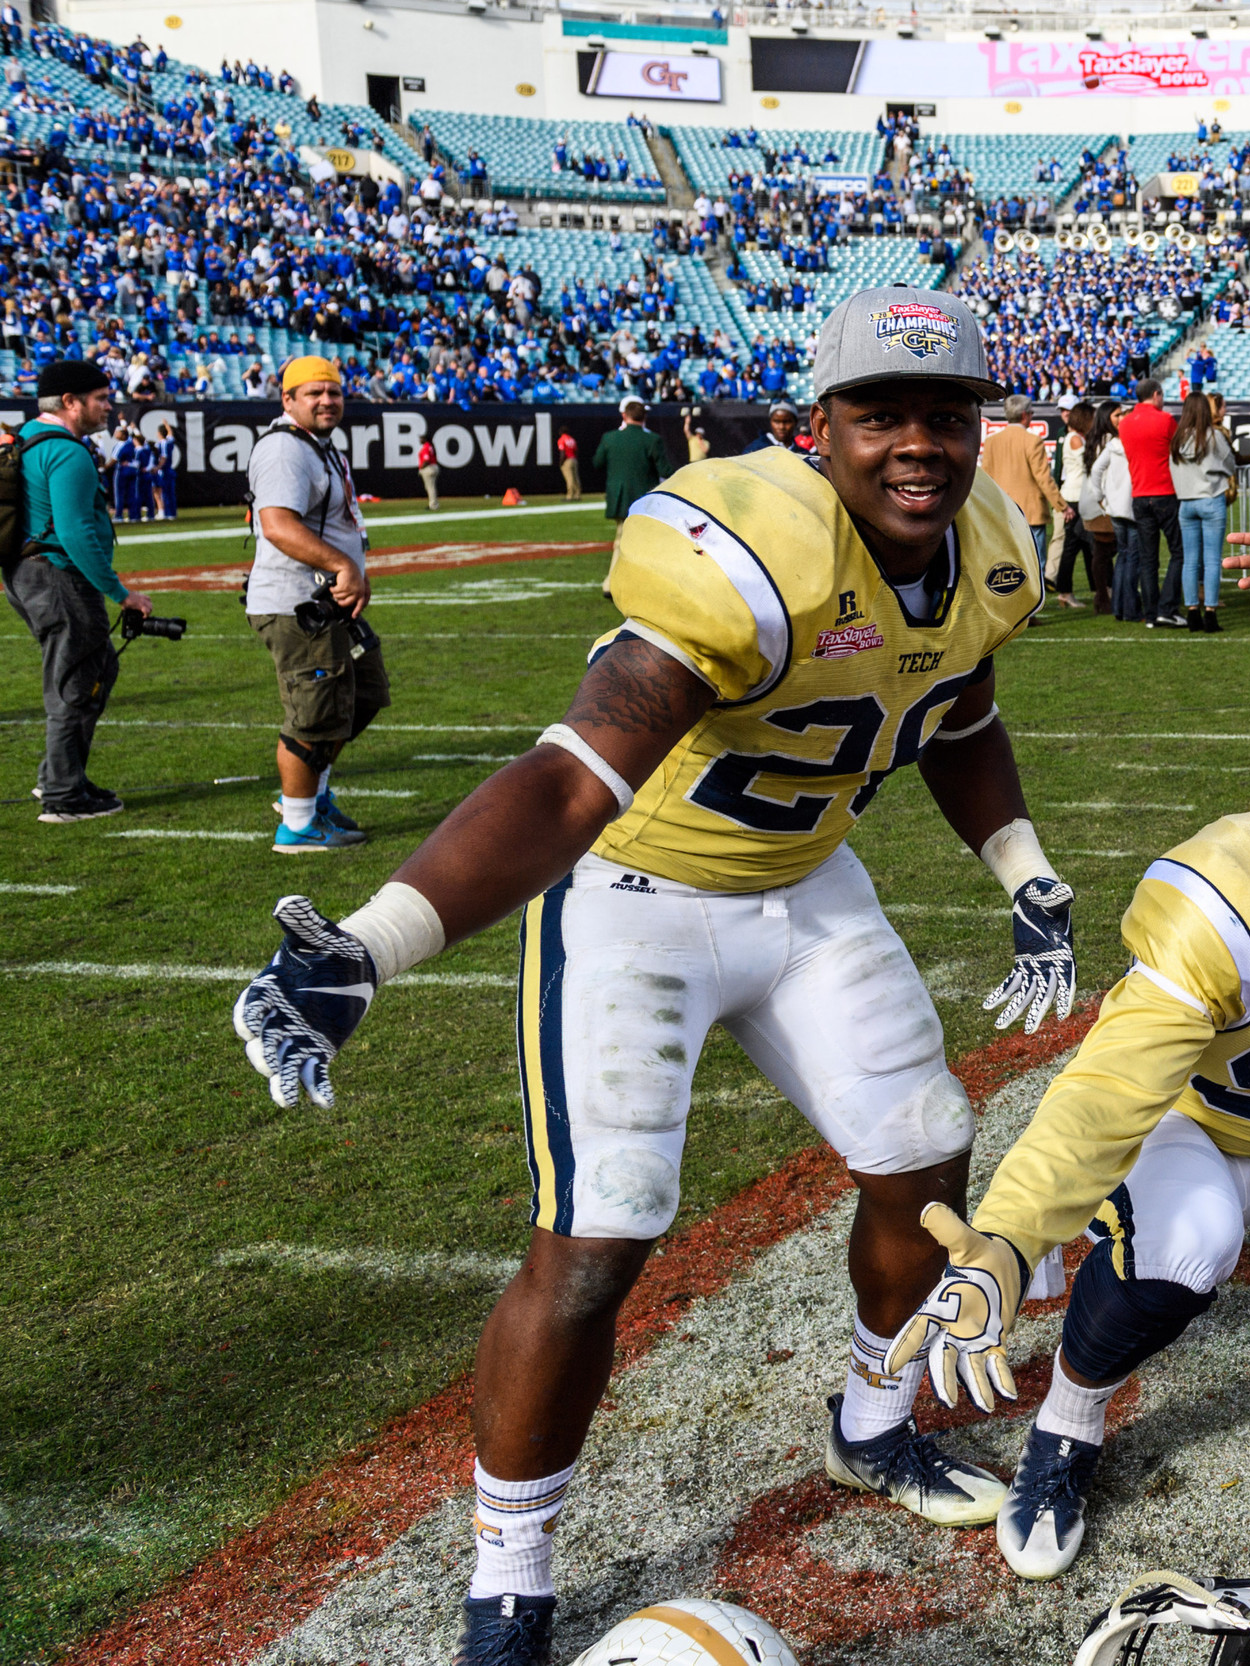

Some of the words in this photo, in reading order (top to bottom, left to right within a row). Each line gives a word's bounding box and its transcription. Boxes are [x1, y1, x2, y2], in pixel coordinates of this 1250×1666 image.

[1081, 53, 1187, 77] TaxSlayer
[642, 61, 688, 92] GT
[1161, 72, 1207, 86] BOWL
[328, 154, 349, 167] 217
[891, 304, 940, 315] TaxSlayer
[878, 317, 957, 340] CHAMPIONS
[902, 330, 940, 354] GT
[990, 569, 1020, 586] ACC
[835, 611, 865, 627] RUSSELL
[819, 625, 877, 646] TaxSlayer
[859, 636, 884, 649] BOWL
[897, 651, 945, 674] TECH
[609, 882, 658, 894] RUSSELL
